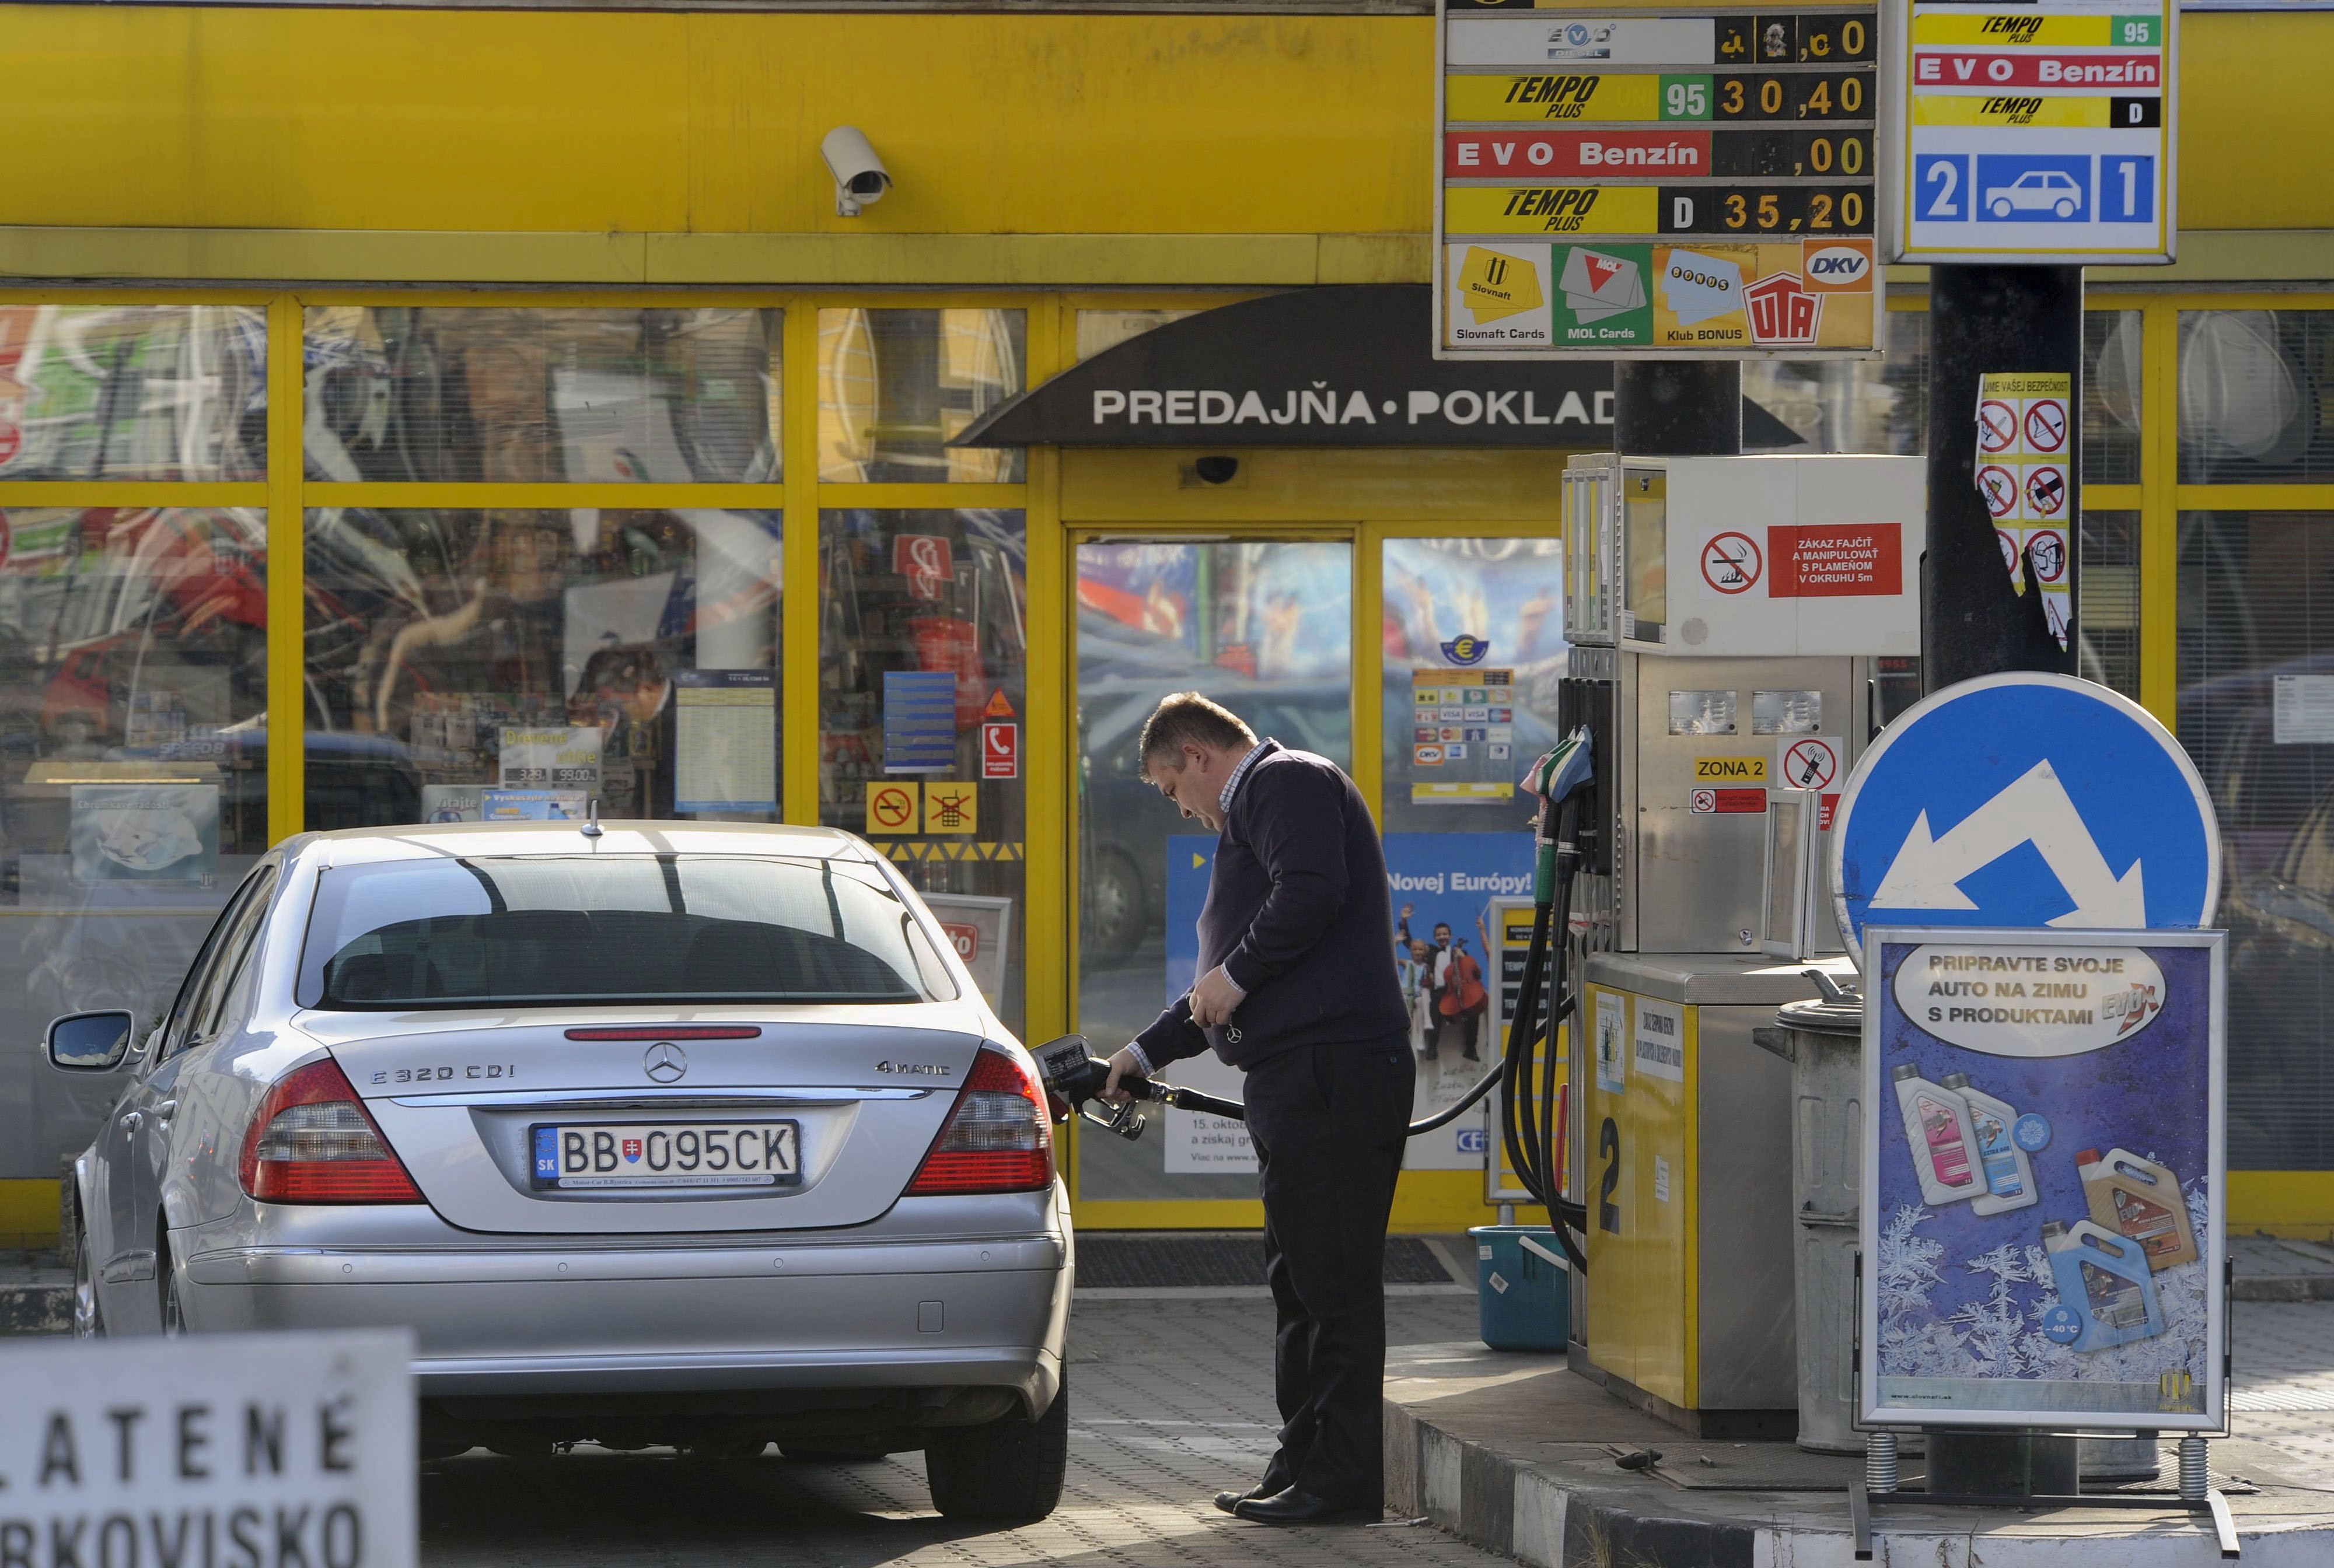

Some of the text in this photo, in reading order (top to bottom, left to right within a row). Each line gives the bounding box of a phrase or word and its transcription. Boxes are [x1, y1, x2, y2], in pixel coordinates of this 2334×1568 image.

[1547, 22, 1612, 47] EVO
[1981, 16, 2150, 43] TEMPO 95
[2007, 33, 2035, 43] PLUS
[2039, 60, 2155, 82] Benzín
[1505, 76, 1863, 118] TEMPO 95 30,40
[1545, 104, 1585, 118] PLUS
[1980, 97, 2143, 124] TEMPO D
[2007, 114, 2034, 124] PLUS
[1580, 142, 1699, 166] Benzín
[1927, 160, 2136, 216] 2 1
[1504, 189, 1863, 231] TEMPO D 35,20
[1544, 216, 1584, 231] PLUS
[1596, 258, 1619, 272] MOL
[1811, 257, 1865, 274] DKV
[1671, 266, 1729, 291] BONUS
[1471, 282, 1511, 300] Slovnaft
[1750, 279, 1816, 338] UTA
[1456, 328, 1545, 340] Slovnaft Cards
[1567, 328, 1636, 339] MOL Cards
[1667, 330, 1743, 341] Klub BONUS
[2001, 379, 2025, 391] VAŠEJ
[1093, 381, 1377, 425] PREDAJŇA
[1798, 537, 1872, 549] ZÁKAZ FAJČIŤ
[1793, 548, 1879, 560] A MANIPULOVAŤ
[1802, 560, 1873, 572] S PLAMEŇOM
[1799, 573, 1873, 583] V OKRUHU 5m
[1698, 761, 1763, 776] ZONA 2
[1387, 872, 1532, 894] Novej Európy!
[1928, 955, 2125, 974] PRIPRAVTE SVOJE
[1928, 981, 1989, 997] AUTO
[1995, 982, 2026, 998] NA
[2032, 983, 2088, 999] ZIMU
[1928, 1006, 2094, 1025] S PRODUKTAMI
[371, 1065, 515, 1085] E 320 CDI
[875, 1060, 951, 1075] 4MATIC
[1193, 1119, 1208, 1130] 15.
[564, 1129, 789, 1172] BB 095CK
[538, 1159, 555, 1171] SK
[1599, 1117, 1620, 1235] 2
[0, 1393, 358, 1489] ATENÉ
